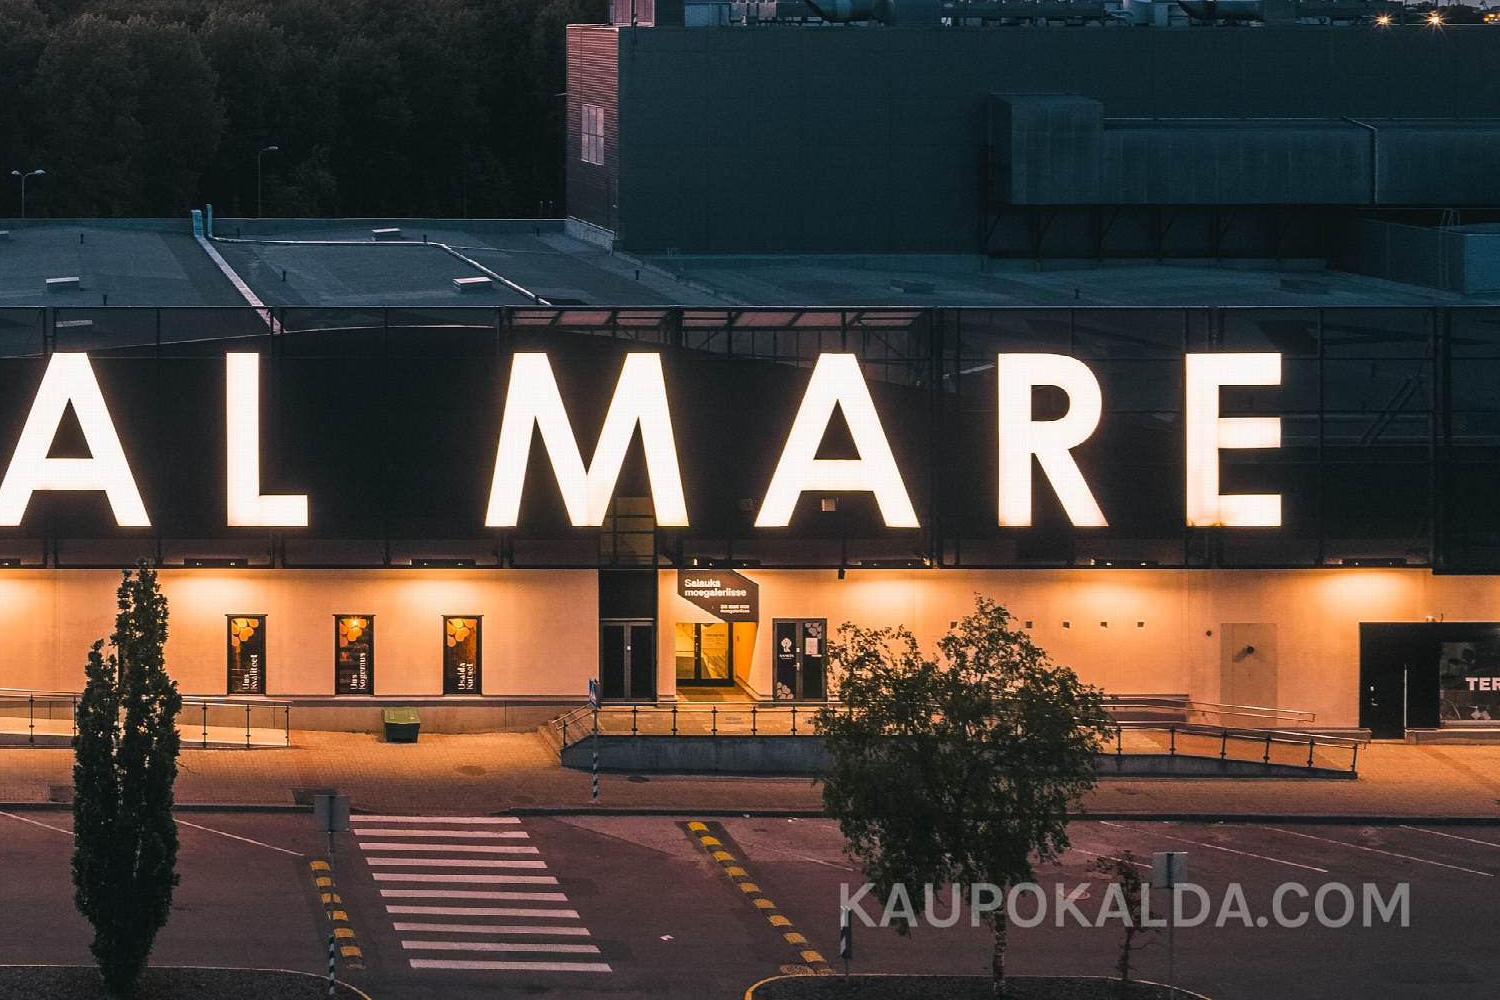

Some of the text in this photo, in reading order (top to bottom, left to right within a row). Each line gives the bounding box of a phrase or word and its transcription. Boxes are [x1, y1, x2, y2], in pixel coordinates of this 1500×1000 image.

[486, 353, 1282, 527] MARE
[684, 578, 721, 588] Salauks
[684, 588, 747, 599] moegaleriisse
